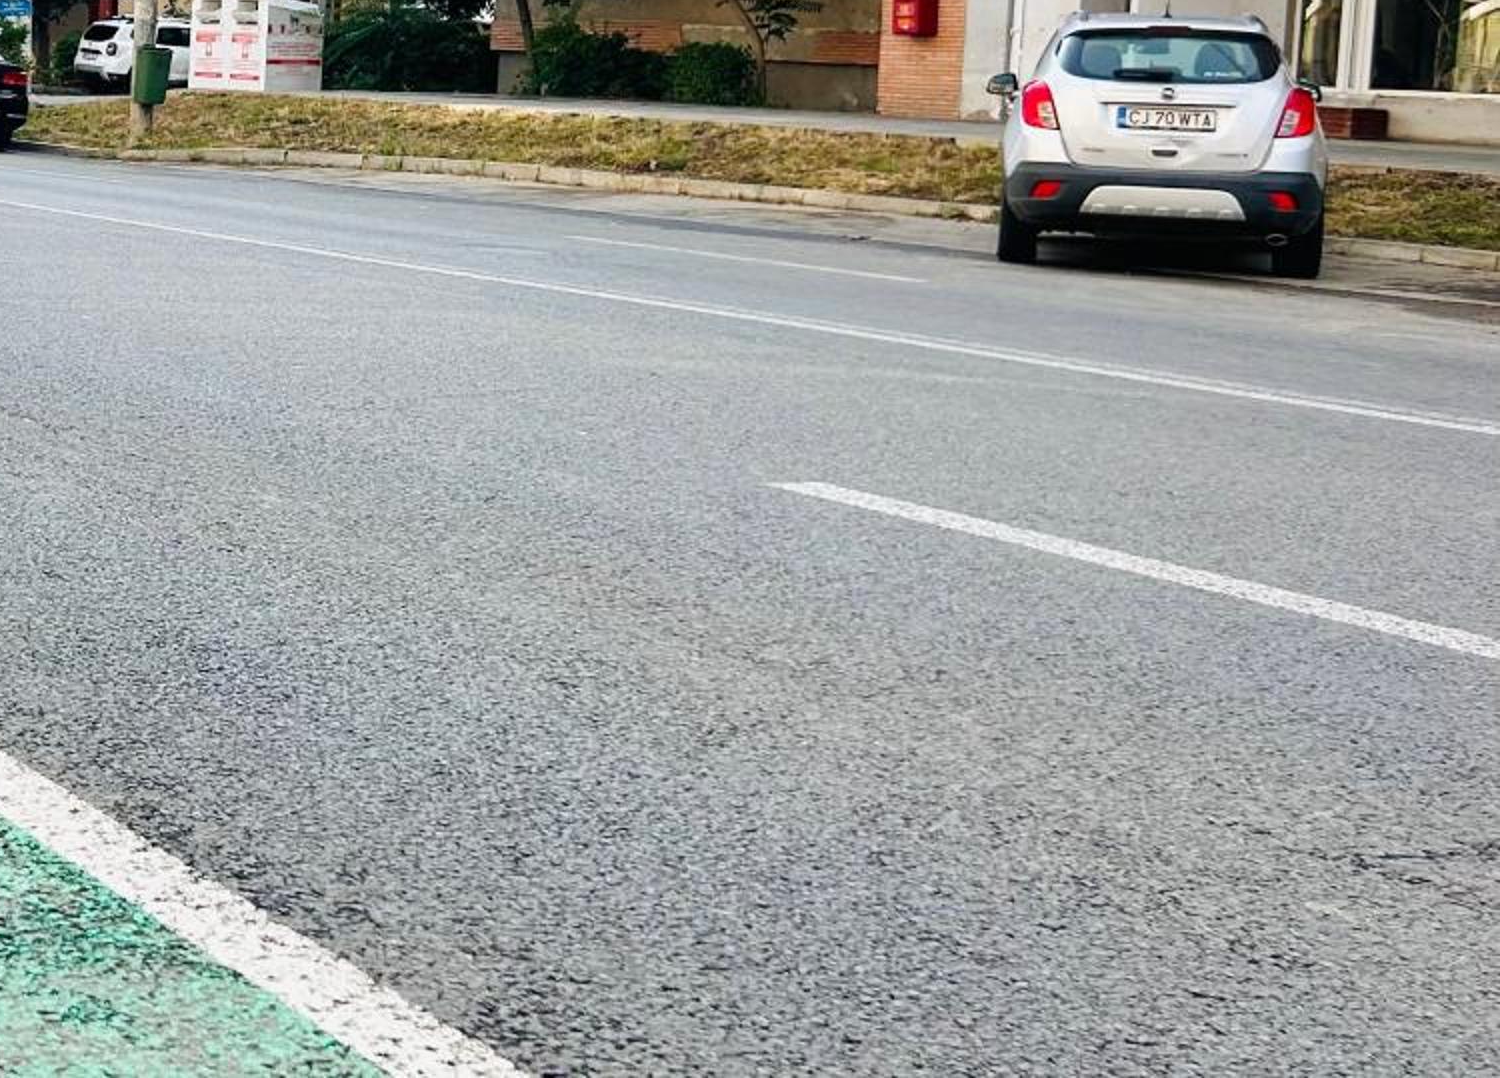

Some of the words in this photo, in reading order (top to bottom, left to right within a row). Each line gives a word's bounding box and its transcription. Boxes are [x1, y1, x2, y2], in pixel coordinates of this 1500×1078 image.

[1129, 111, 1149, 124] CJ
[1155, 111, 1175, 124] 70
[1180, 112, 1211, 126] WTA
